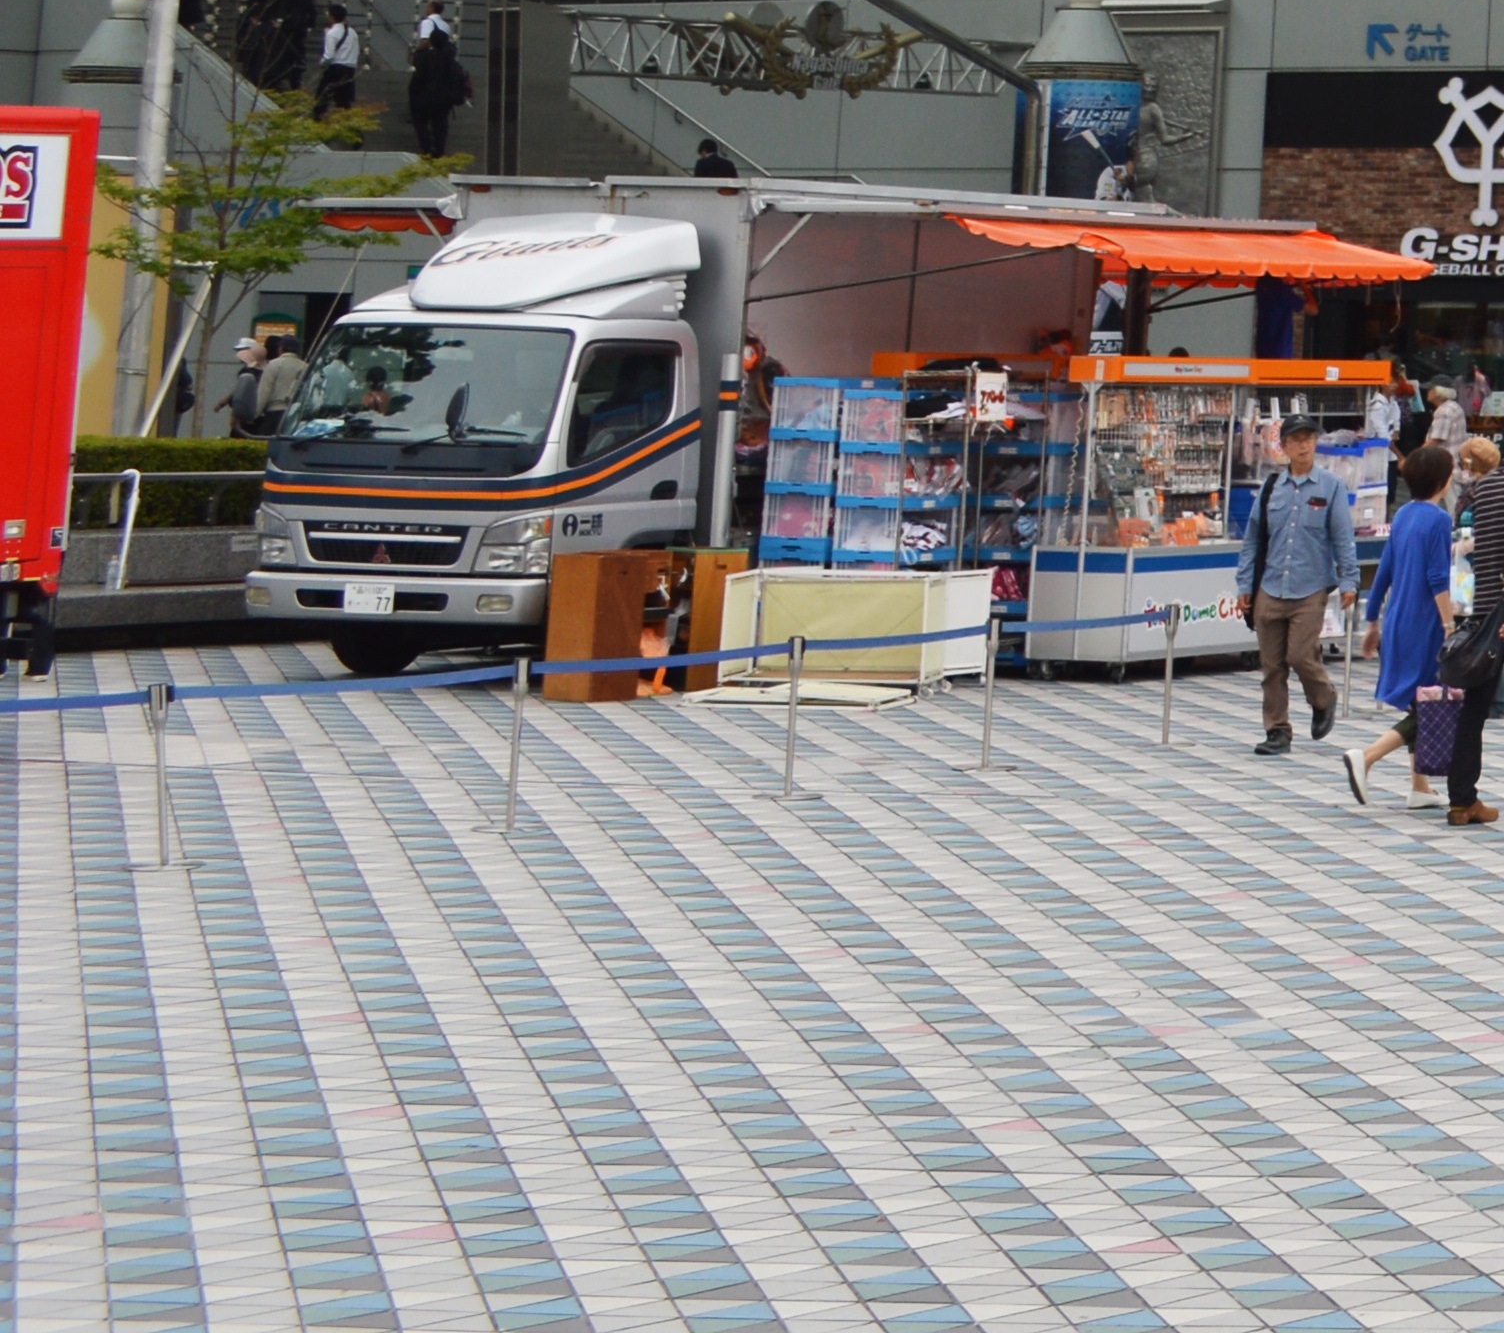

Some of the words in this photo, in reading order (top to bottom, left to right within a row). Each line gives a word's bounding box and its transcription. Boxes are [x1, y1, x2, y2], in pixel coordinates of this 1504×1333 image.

[1405, 23, 1450, 42] ゲート
[1404, 45, 1450, 62] GATE
[429, 234, 618, 268] Giants
[323, 522, 444, 533] CANTER
[1183, 604, 1217, 622] Dome
